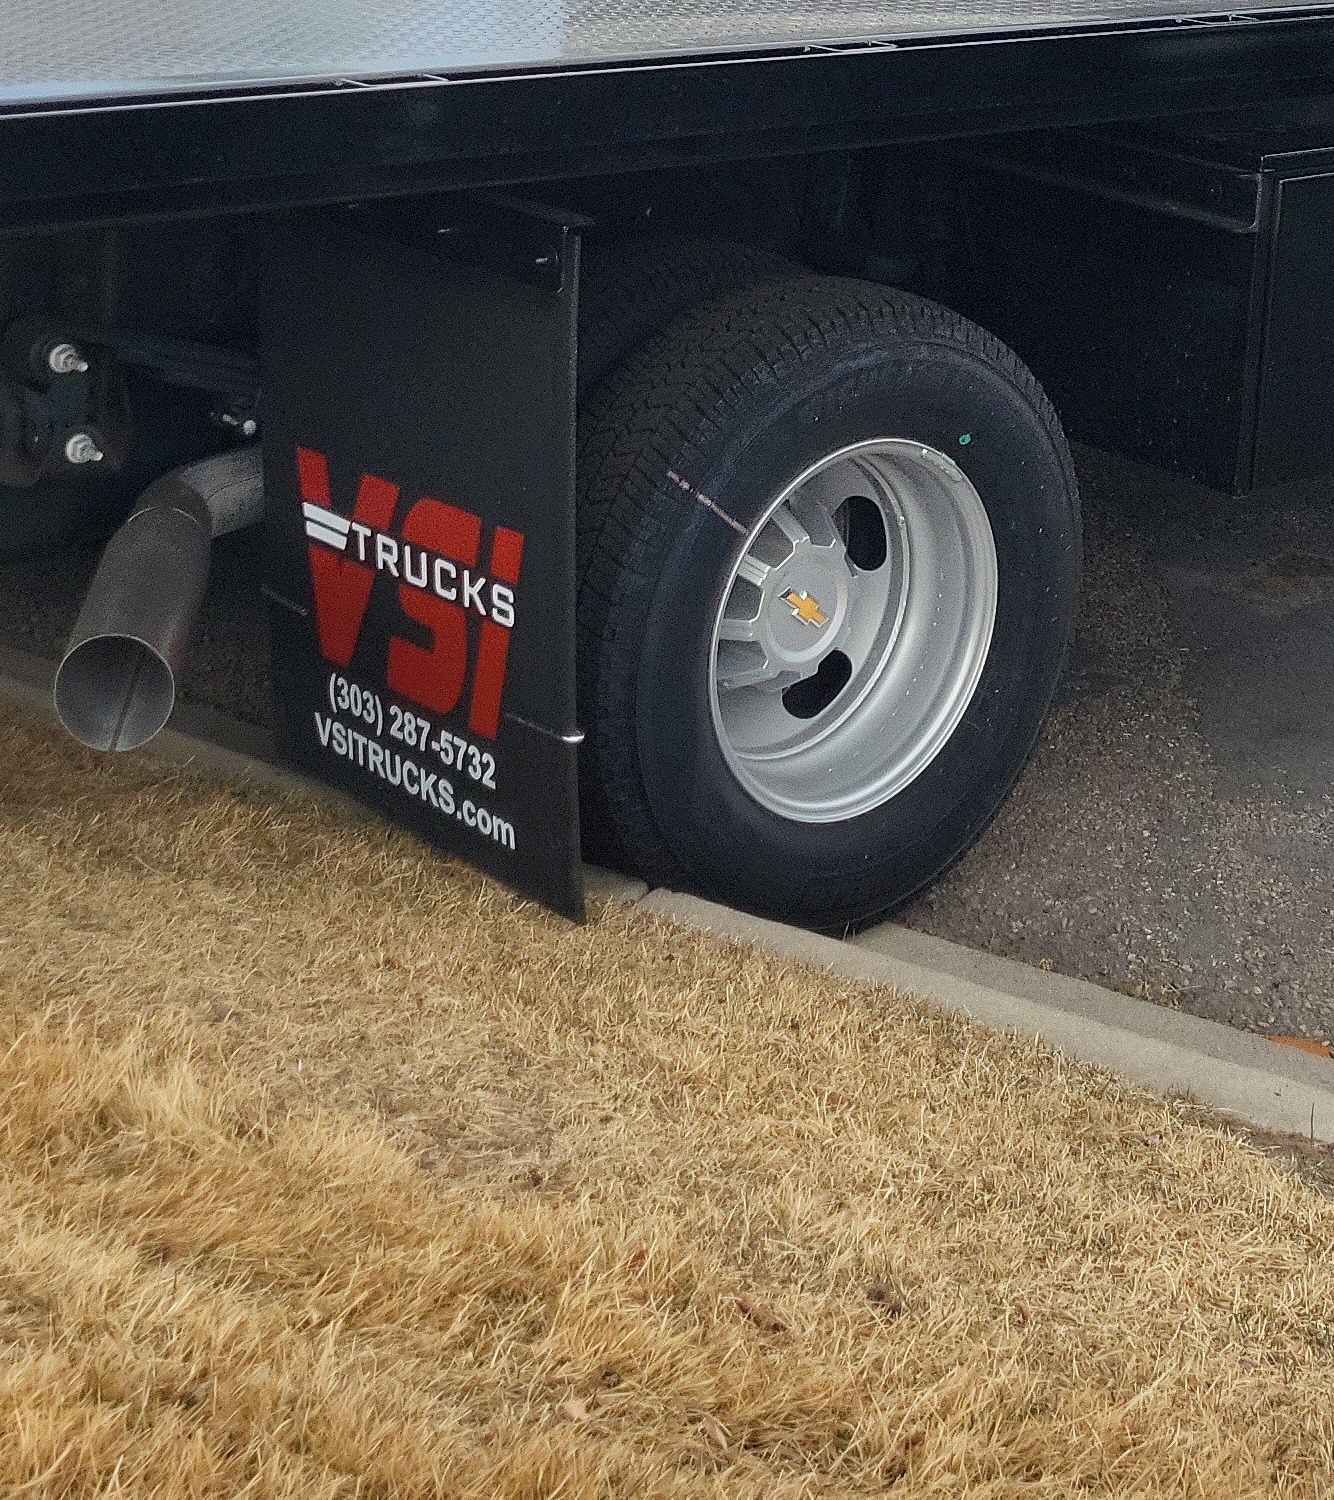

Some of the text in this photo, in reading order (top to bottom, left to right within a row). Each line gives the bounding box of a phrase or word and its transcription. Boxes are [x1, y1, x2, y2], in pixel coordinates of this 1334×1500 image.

[351, 521, 515, 628] TRUCKS
[315, 711, 516, 850] VSITRUCKS.com
[329, 672, 496, 790] (303) 287-5732
